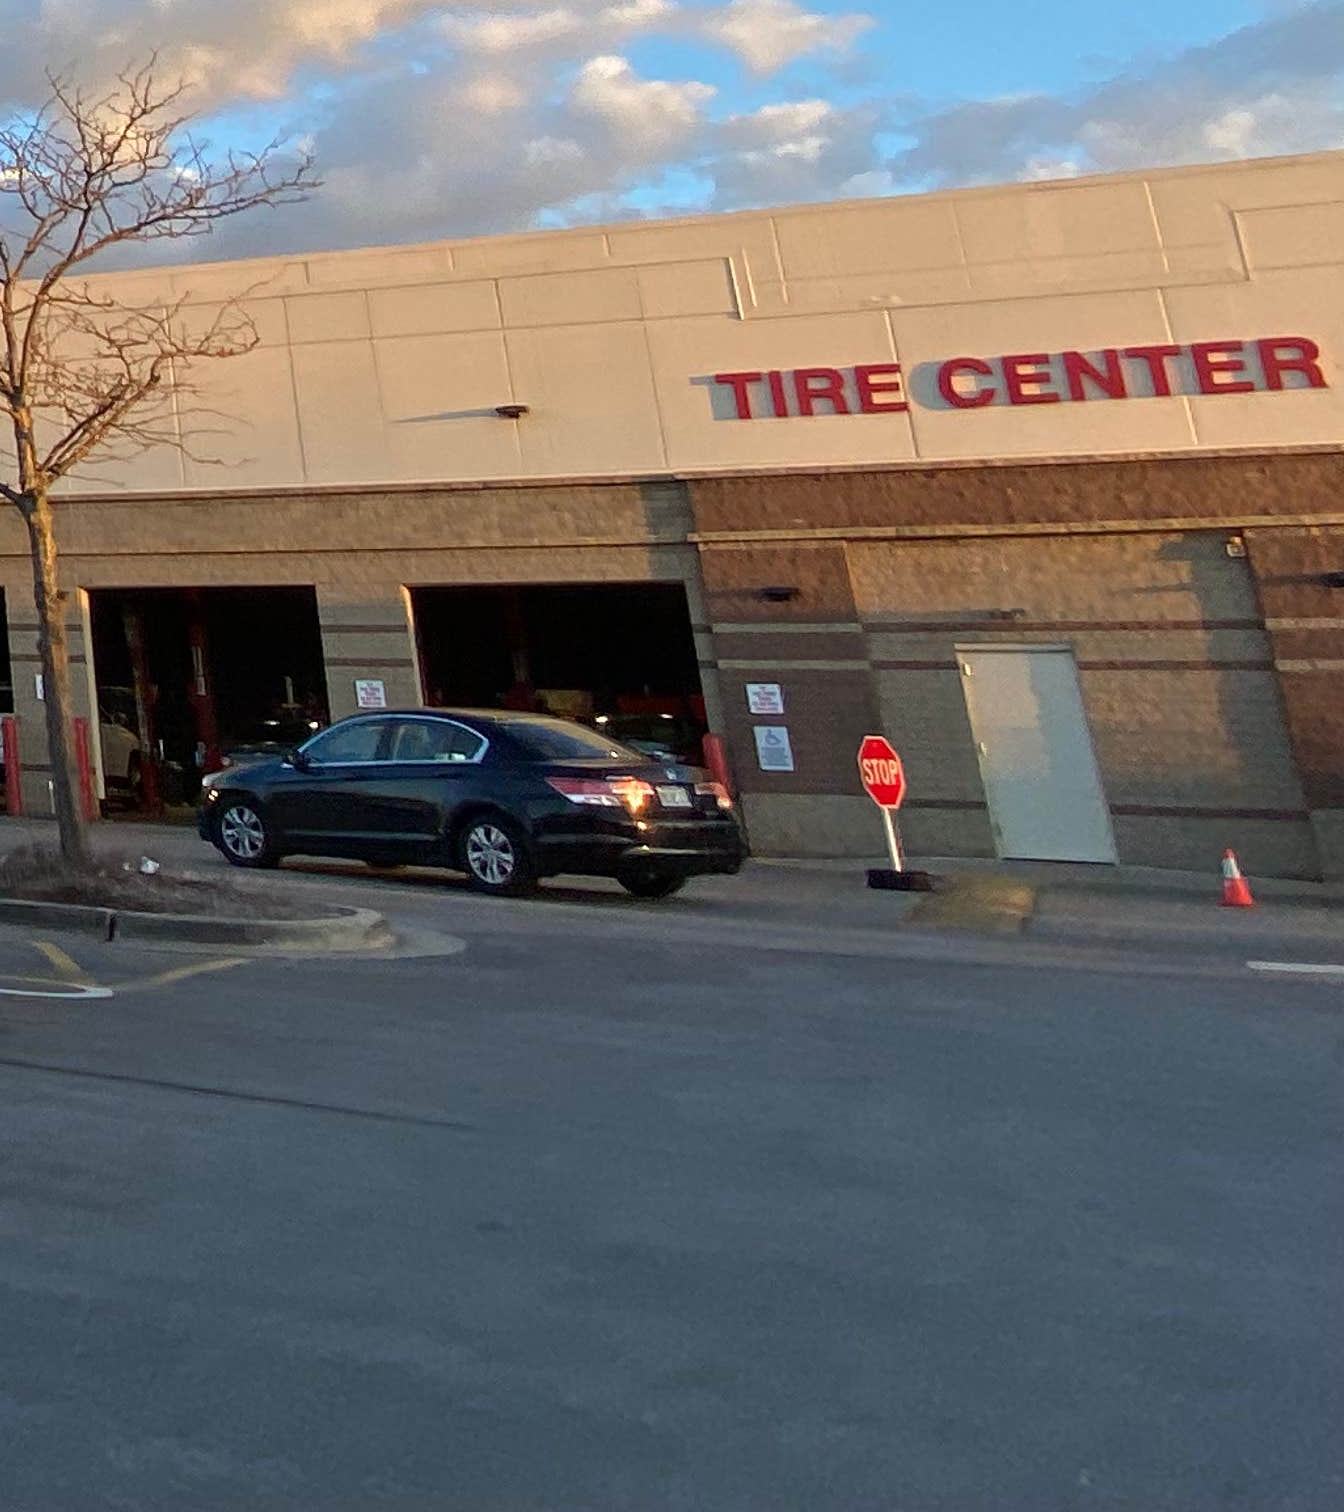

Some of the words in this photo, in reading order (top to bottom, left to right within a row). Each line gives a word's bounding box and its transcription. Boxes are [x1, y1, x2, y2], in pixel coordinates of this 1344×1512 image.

[714, 362, 909, 420] TIRE
[937, 336, 1330, 410] CENTER
[862, 758, 898, 786] STOP
